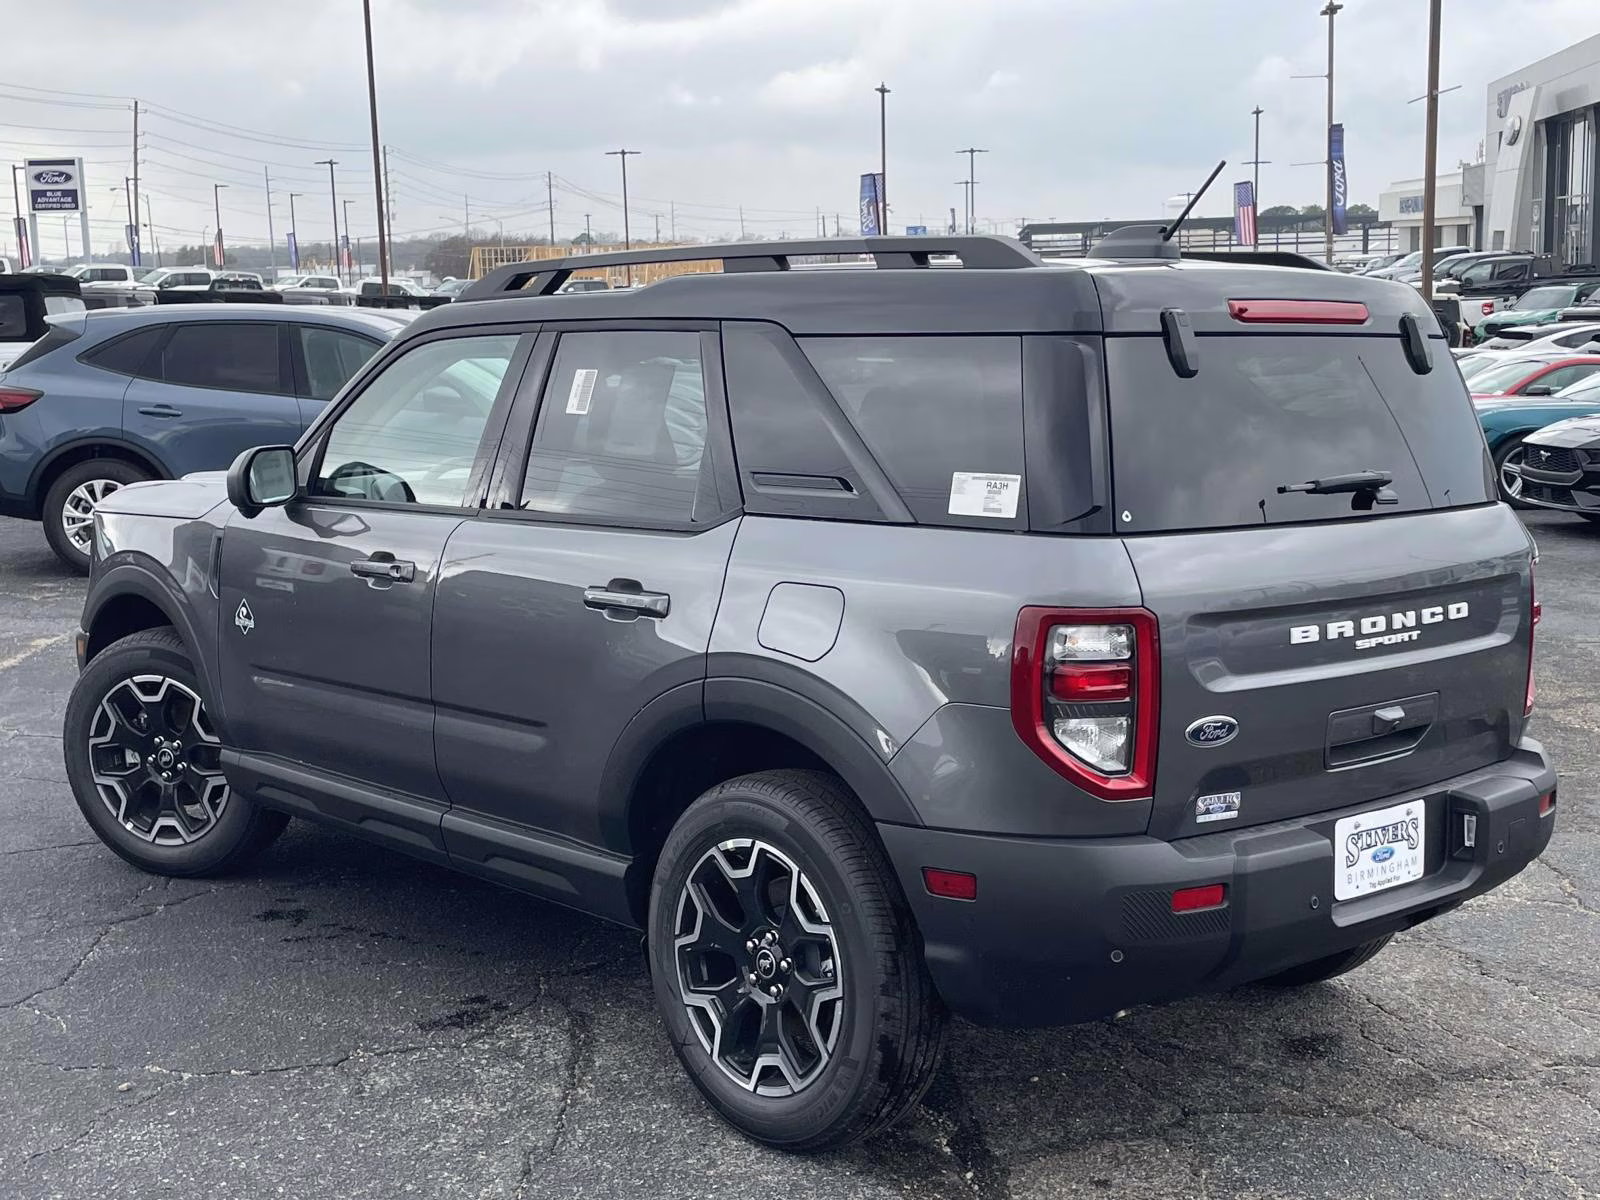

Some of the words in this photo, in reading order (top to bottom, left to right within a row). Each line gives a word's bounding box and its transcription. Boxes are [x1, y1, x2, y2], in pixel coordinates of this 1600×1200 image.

[40, 171, 66, 183] Ford
[1333, 160, 1344, 206] Ford
[1290, 602, 1469, 644] BRONCO
[1355, 630, 1421, 650] SPORT
[1200, 722, 1229, 740] Ford
[1345, 817, 1419, 869] STIVERS
[1347, 856, 1417, 885] BIRMINGHAM
